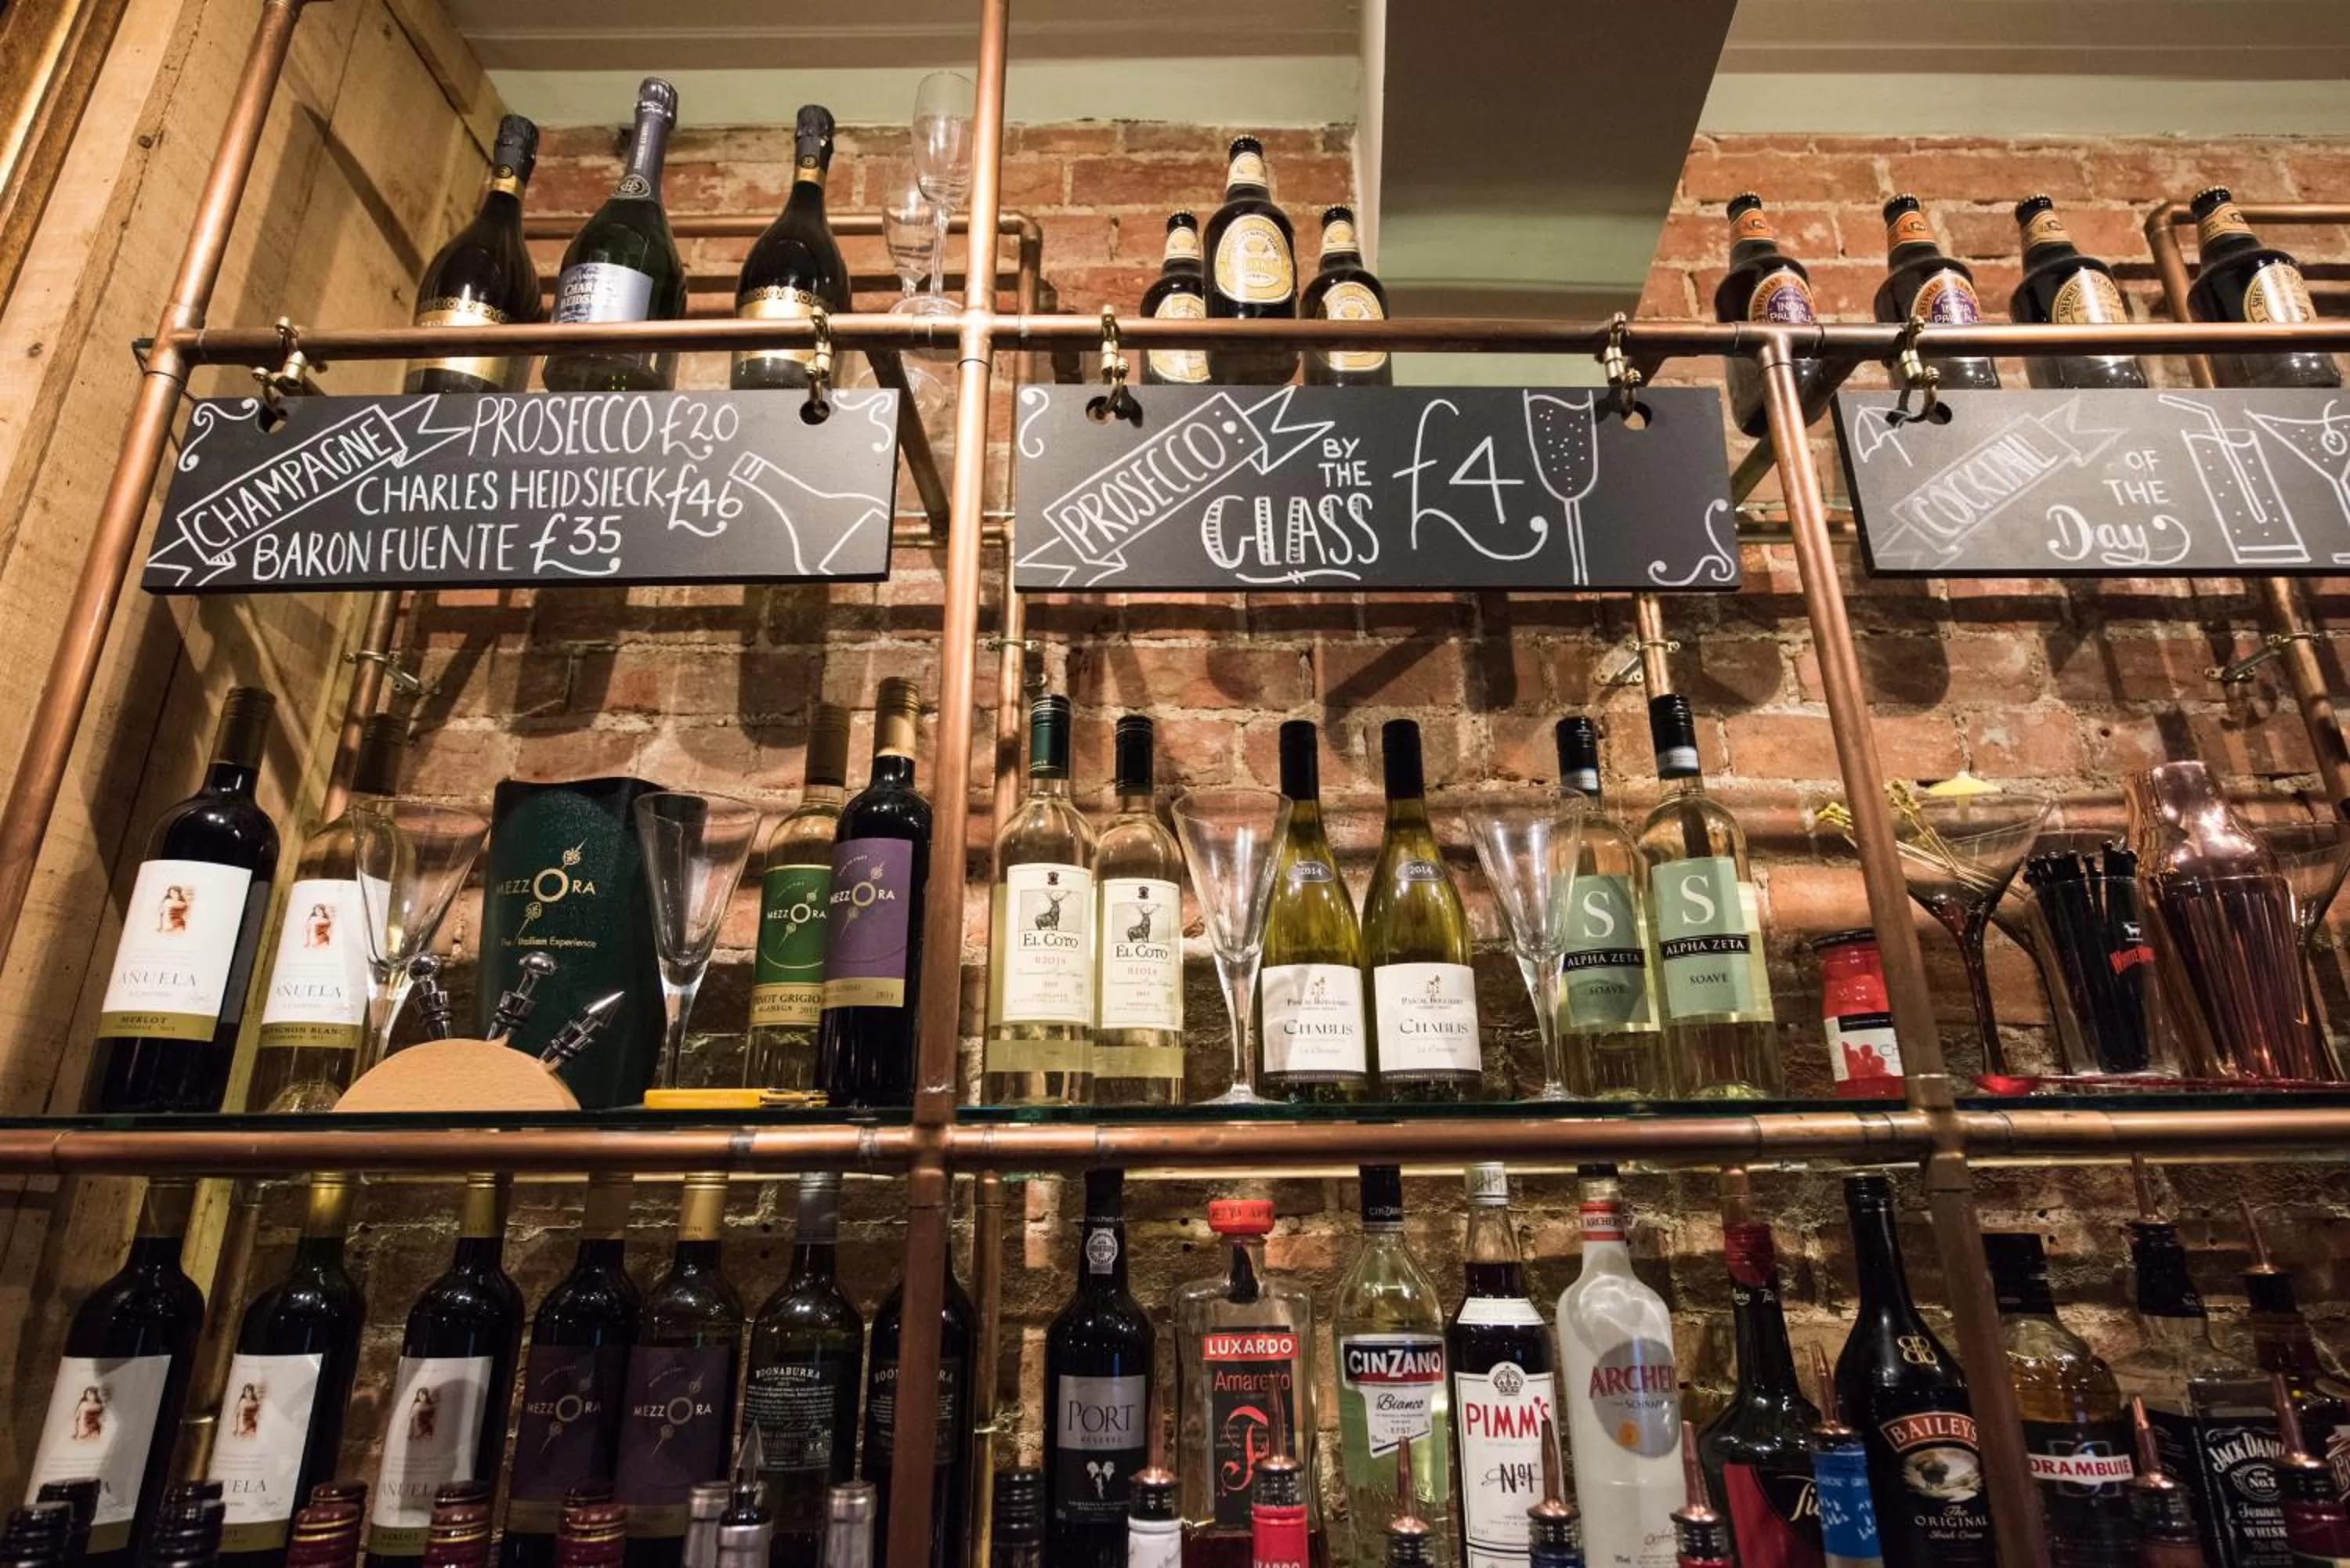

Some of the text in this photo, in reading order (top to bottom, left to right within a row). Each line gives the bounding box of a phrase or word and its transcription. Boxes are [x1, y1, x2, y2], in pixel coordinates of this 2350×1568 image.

[468, 396, 739, 461] PROSECCO £20
[1322, 437, 1361, 459] BY
[2125, 450, 2160, 472] OF
[193, 416, 392, 547] CHAMPAGNE
[1059, 421, 1226, 555] PROSECCO
[1318, 460, 1372, 488] THE
[1391, 398, 1549, 562] £4
[1911, 433, 2059, 538] COCKTAIL
[356, 464, 743, 537] CHARLES HEIDSIECK £46
[2102, 478, 2171, 507] THE
[1200, 493, 1380, 569] GLASS
[2044, 504, 2192, 566] Day
[252, 513, 622, 581] BARON FUENTE £35
[1582, 891, 1614, 938] S
[1680, 875, 1716, 925] S
[549, 936, 597, 948] Experience
[1665, 938, 1746, 956] ALPHA ZETA
[1567, 952, 1640, 968] ALPHA ZETA
[1689, 973, 1730, 985] SOAVE
[1208, 1338, 1292, 1355] LUXARDO
[1347, 1349, 1442, 1378] CINZANO
[1589, 1365, 1677, 1399] ARCHER
[1067, 1400, 1135, 1433] PORT
[1376, 1393, 1425, 1411] Bianco
[1889, 1416, 1978, 1446] BAILEYS
[2030, 1458, 2131, 1476] DRAMBUIE
[2207, 1437, 2247, 1473] JACK
[1914, 1515, 1990, 1528] ORIGINAL
[2243, 1527, 2288, 1538] WHISK
